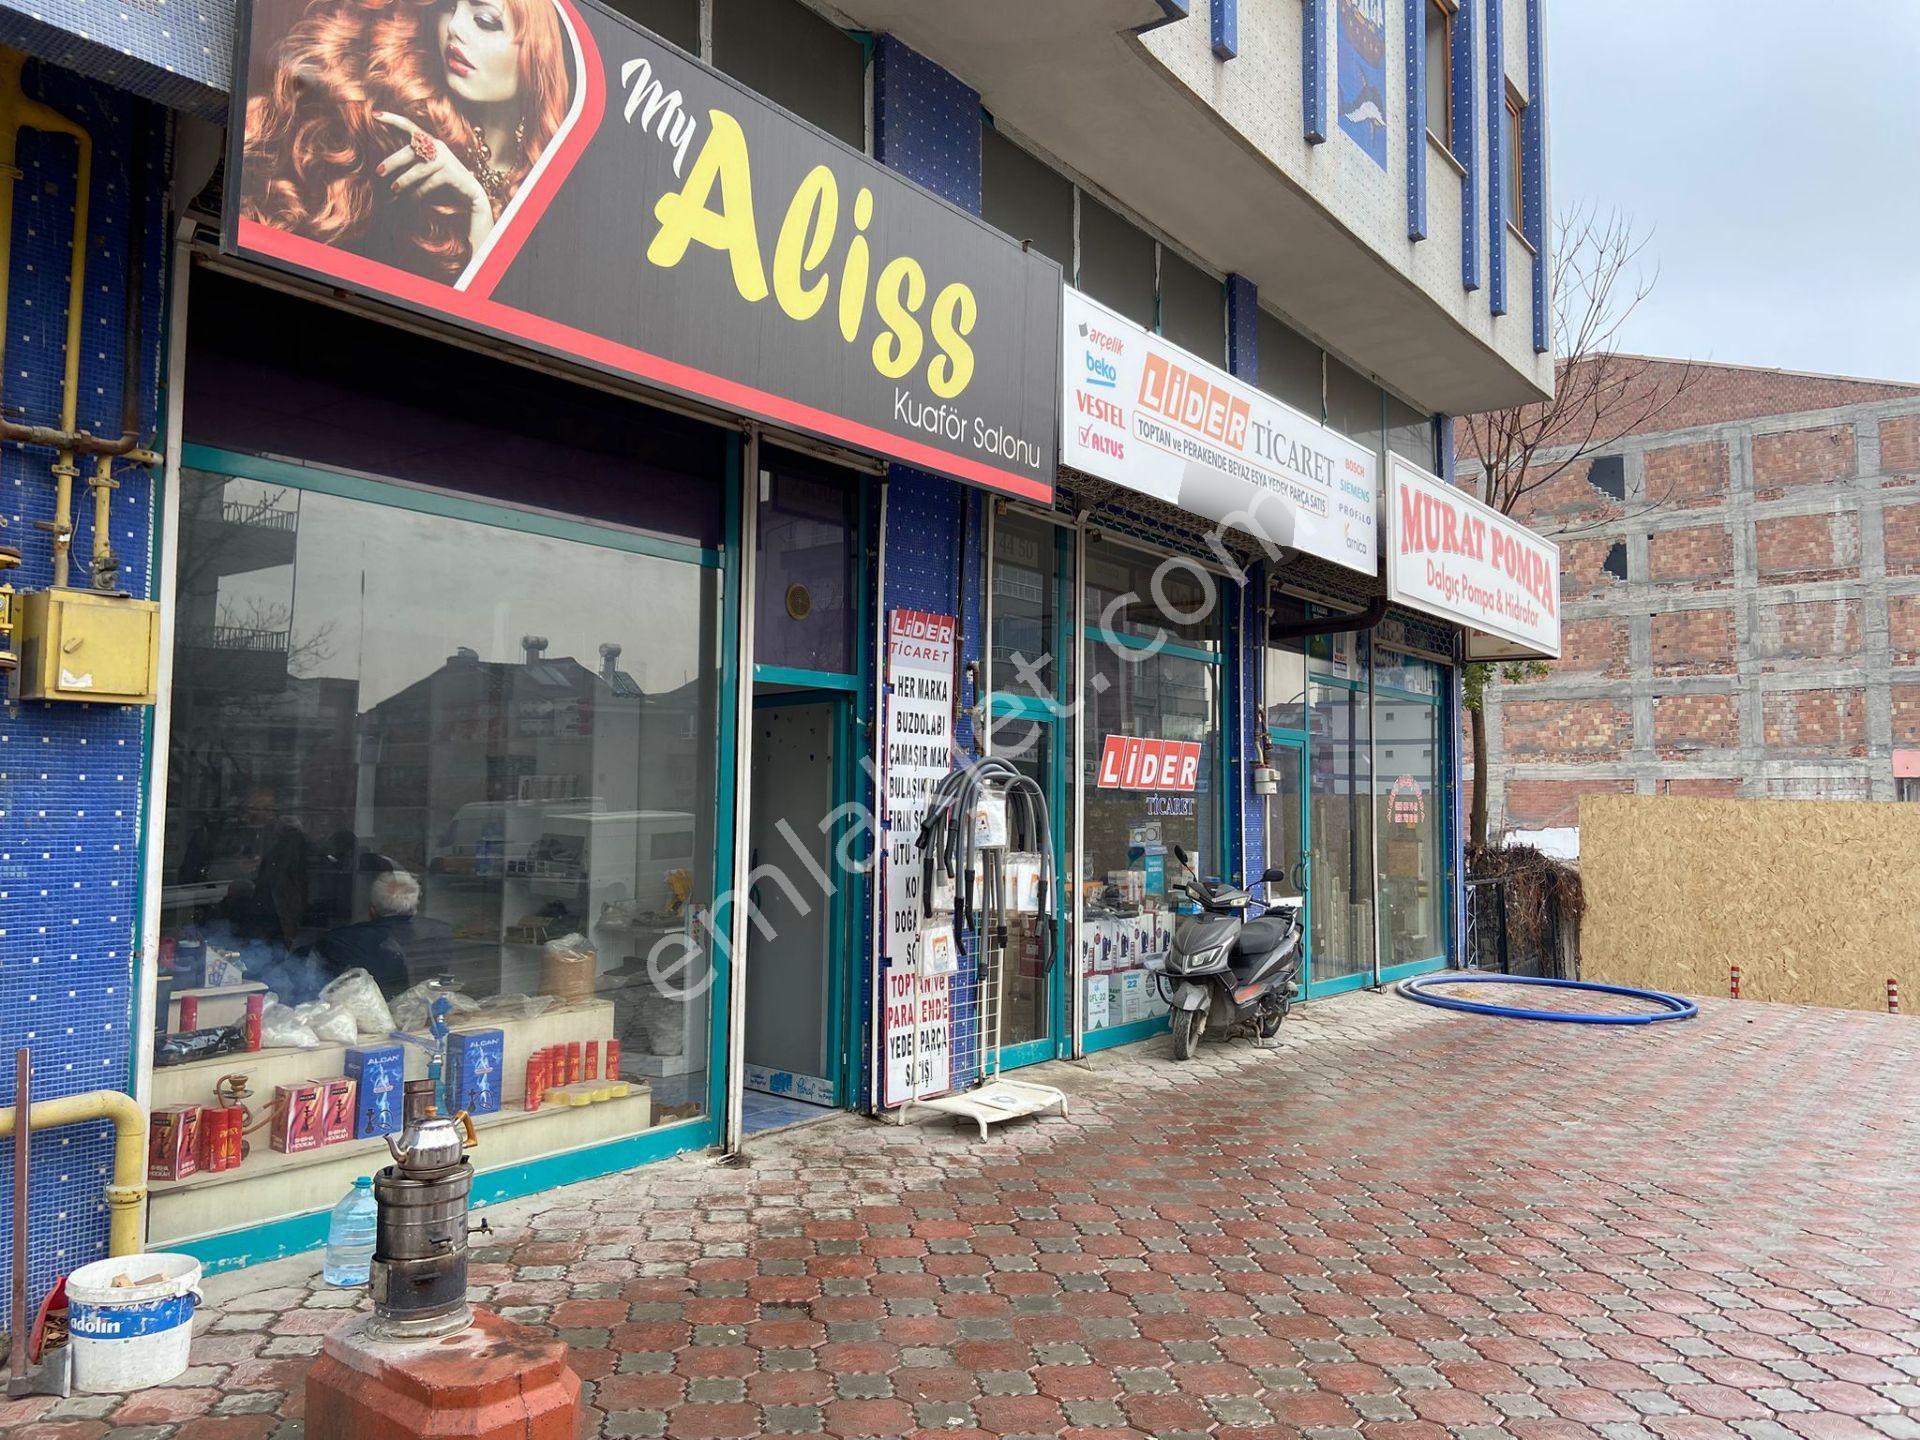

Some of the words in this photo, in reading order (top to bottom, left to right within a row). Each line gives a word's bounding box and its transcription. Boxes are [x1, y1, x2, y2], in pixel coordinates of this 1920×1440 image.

[647, 109, 977, 398] Aliss
[1090, 328, 1125, 355] arçelik
[1086, 350, 1116, 381] beko
[1076, 389, 1126, 430] VESTEL
[894, 387, 967, 442] Kuaför
[973, 416, 1041, 469] Salonu
[1091, 433, 1124, 460] ALTUS
[1138, 419, 1171, 447] TOPTAN
[1172, 438, 1182, 452] ve
[1183, 438, 1227, 472] PERAKENDE
[1228, 459, 1250, 481] BEYAZ
[1268, 476, 1289, 497] YEDEK
[1252, 419, 1335, 488] TİCARET
[1344, 458, 1365, 477] BOSCH
[1340, 479, 1370, 503] SIEMENS
[1400, 483, 1485, 562] MURAT
[1490, 527, 1555, 618] POMPA
[1462, 574, 1494, 614] Pompa
[1497, 589, 1504, 613] &
[1505, 592, 1540, 628] Hidrofor
[890, 641, 949, 663] TİCARET
[898, 675, 915, 698] HER
[918, 678, 948, 702] MARKA
[896, 711, 945, 736] BUZDOLABI
[889, 743, 928, 772] ÇAMAŞIR
[930, 746, 950, 768] MAK.
[893, 838, 911, 865] ÜTÜ
[888, 998, 948, 1030] PARAENDE
[890, 1033, 914, 1060] YEDE
[920, 1027, 947, 1056] PARÇA
